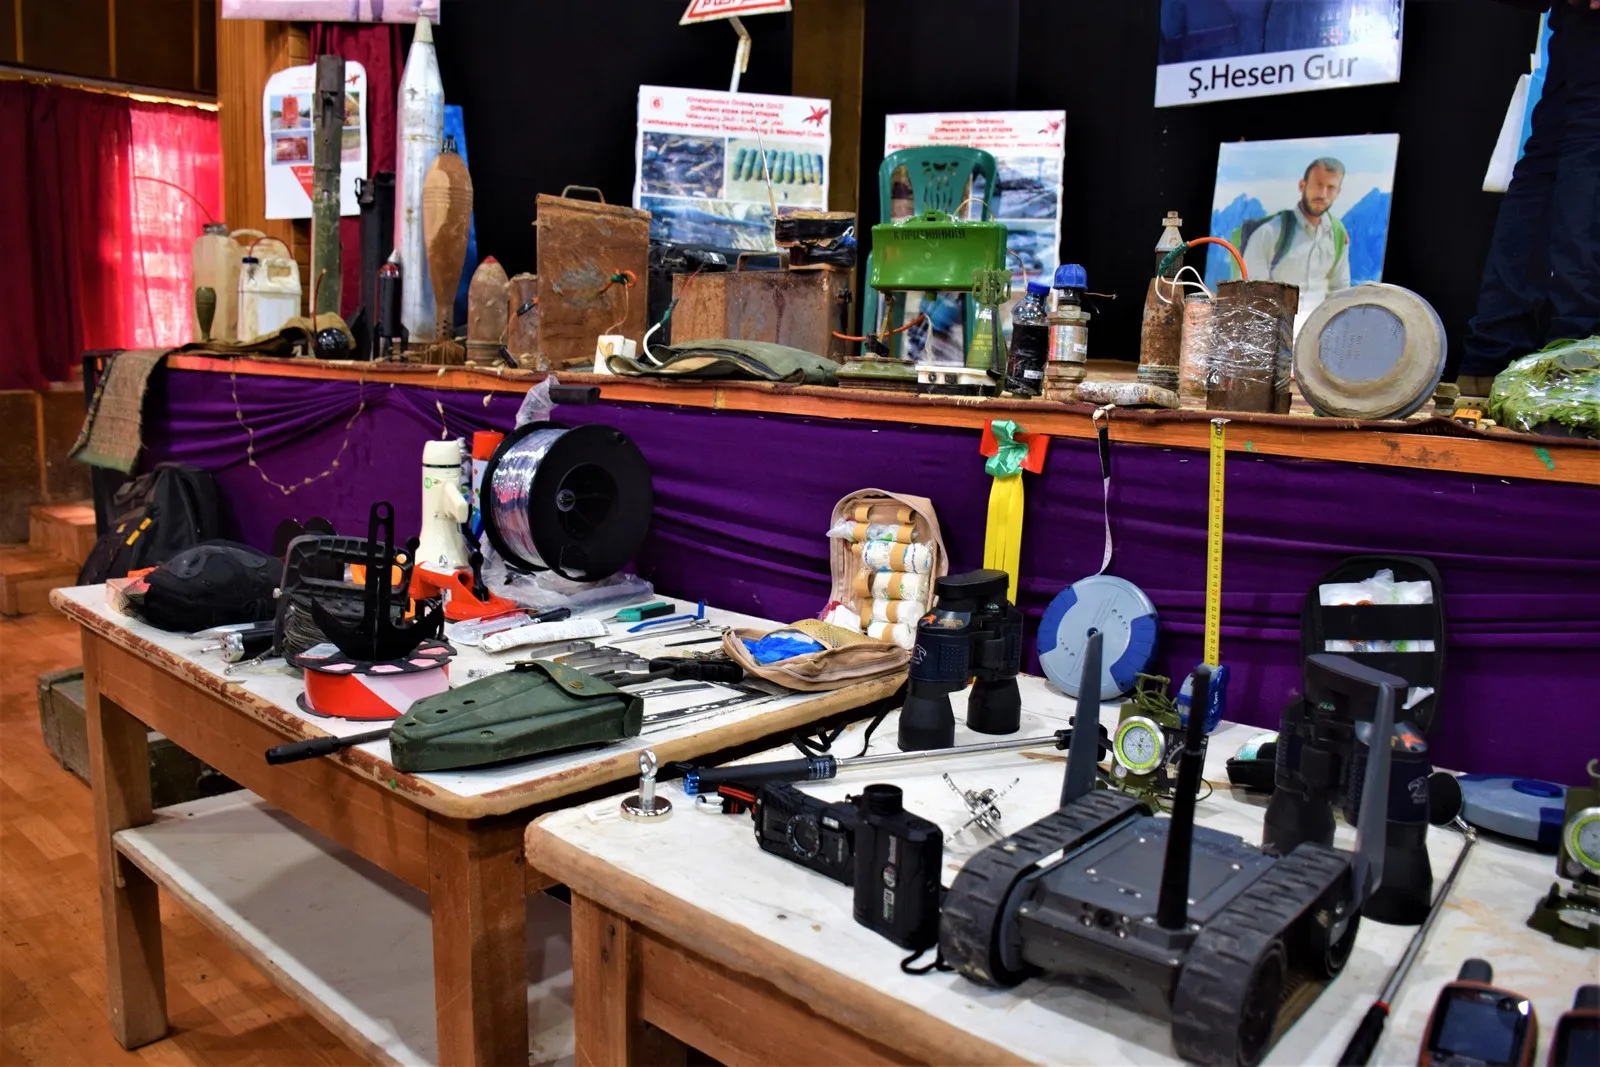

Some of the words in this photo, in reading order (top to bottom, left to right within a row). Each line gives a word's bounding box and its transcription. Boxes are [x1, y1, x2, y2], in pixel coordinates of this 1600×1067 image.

[1188, 63, 1294, 98] Ş.Hesen
[1304, 54, 1358, 80] Gur
[653, 98, 660, 108] 6
[690, 105, 720, 114] Different
[756, 110, 780, 118] shapes
